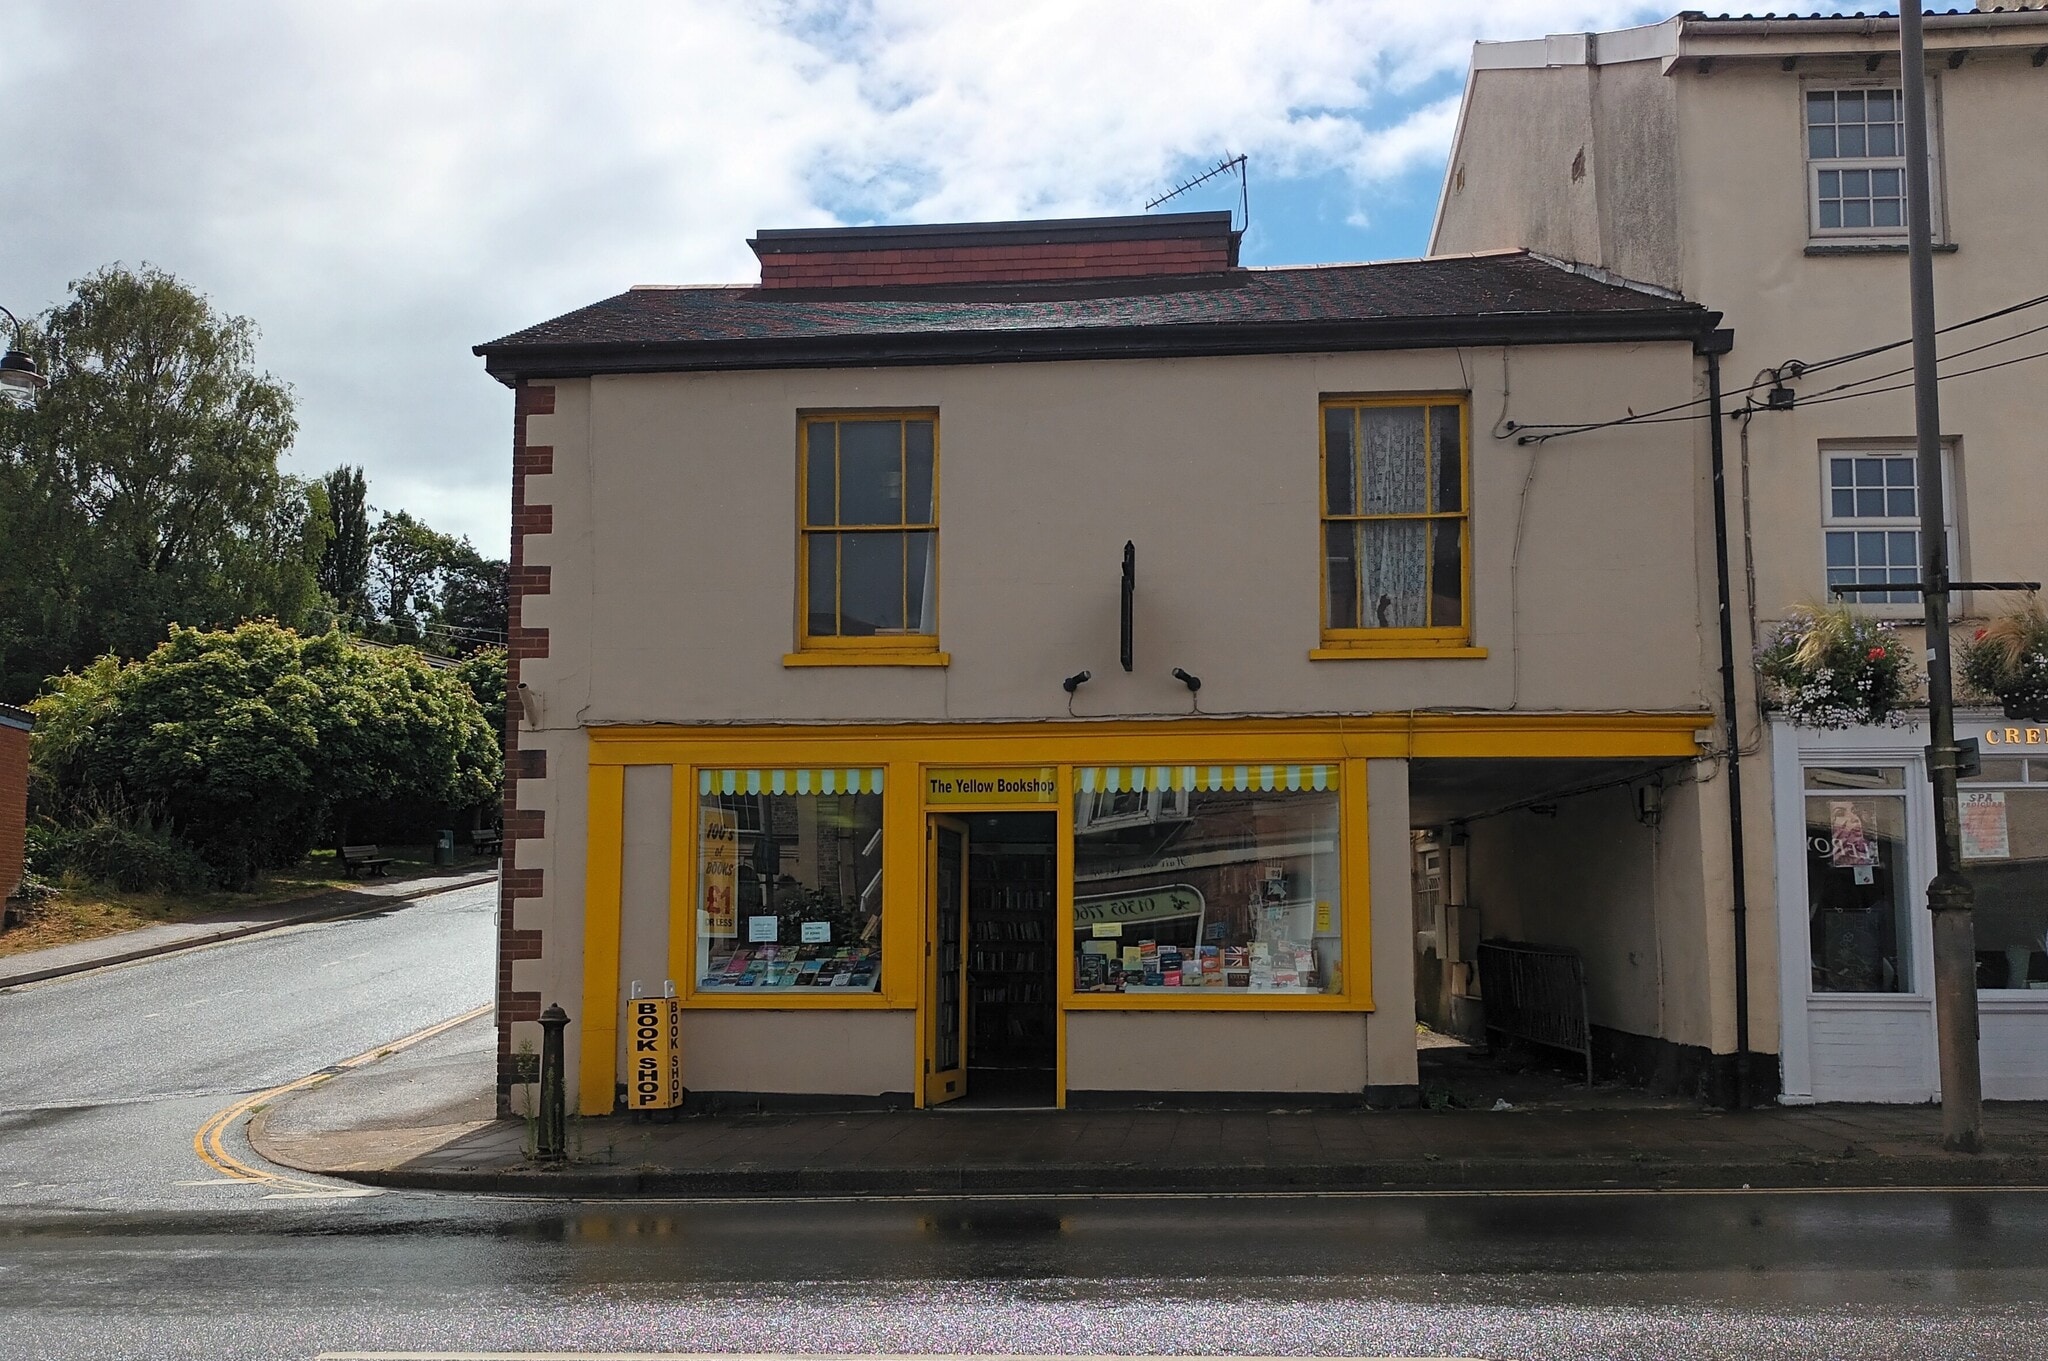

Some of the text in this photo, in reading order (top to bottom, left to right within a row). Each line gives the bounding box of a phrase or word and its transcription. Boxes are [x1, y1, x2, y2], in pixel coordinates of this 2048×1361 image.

[1985, 727, 2048, 745] CRE
[930, 778, 1055, 795] The Yellow Bookshop
[1969, 793, 1993, 802] SPA
[714, 845, 725, 857] of
[705, 861, 734, 876] BOOKS
[706, 885, 731, 915] £1
[705, 918, 733, 927] OR LESS
[636, 1003, 659, 1106] BOOK SHOP
[670, 1001, 680, 1104] BOOK SHOP
